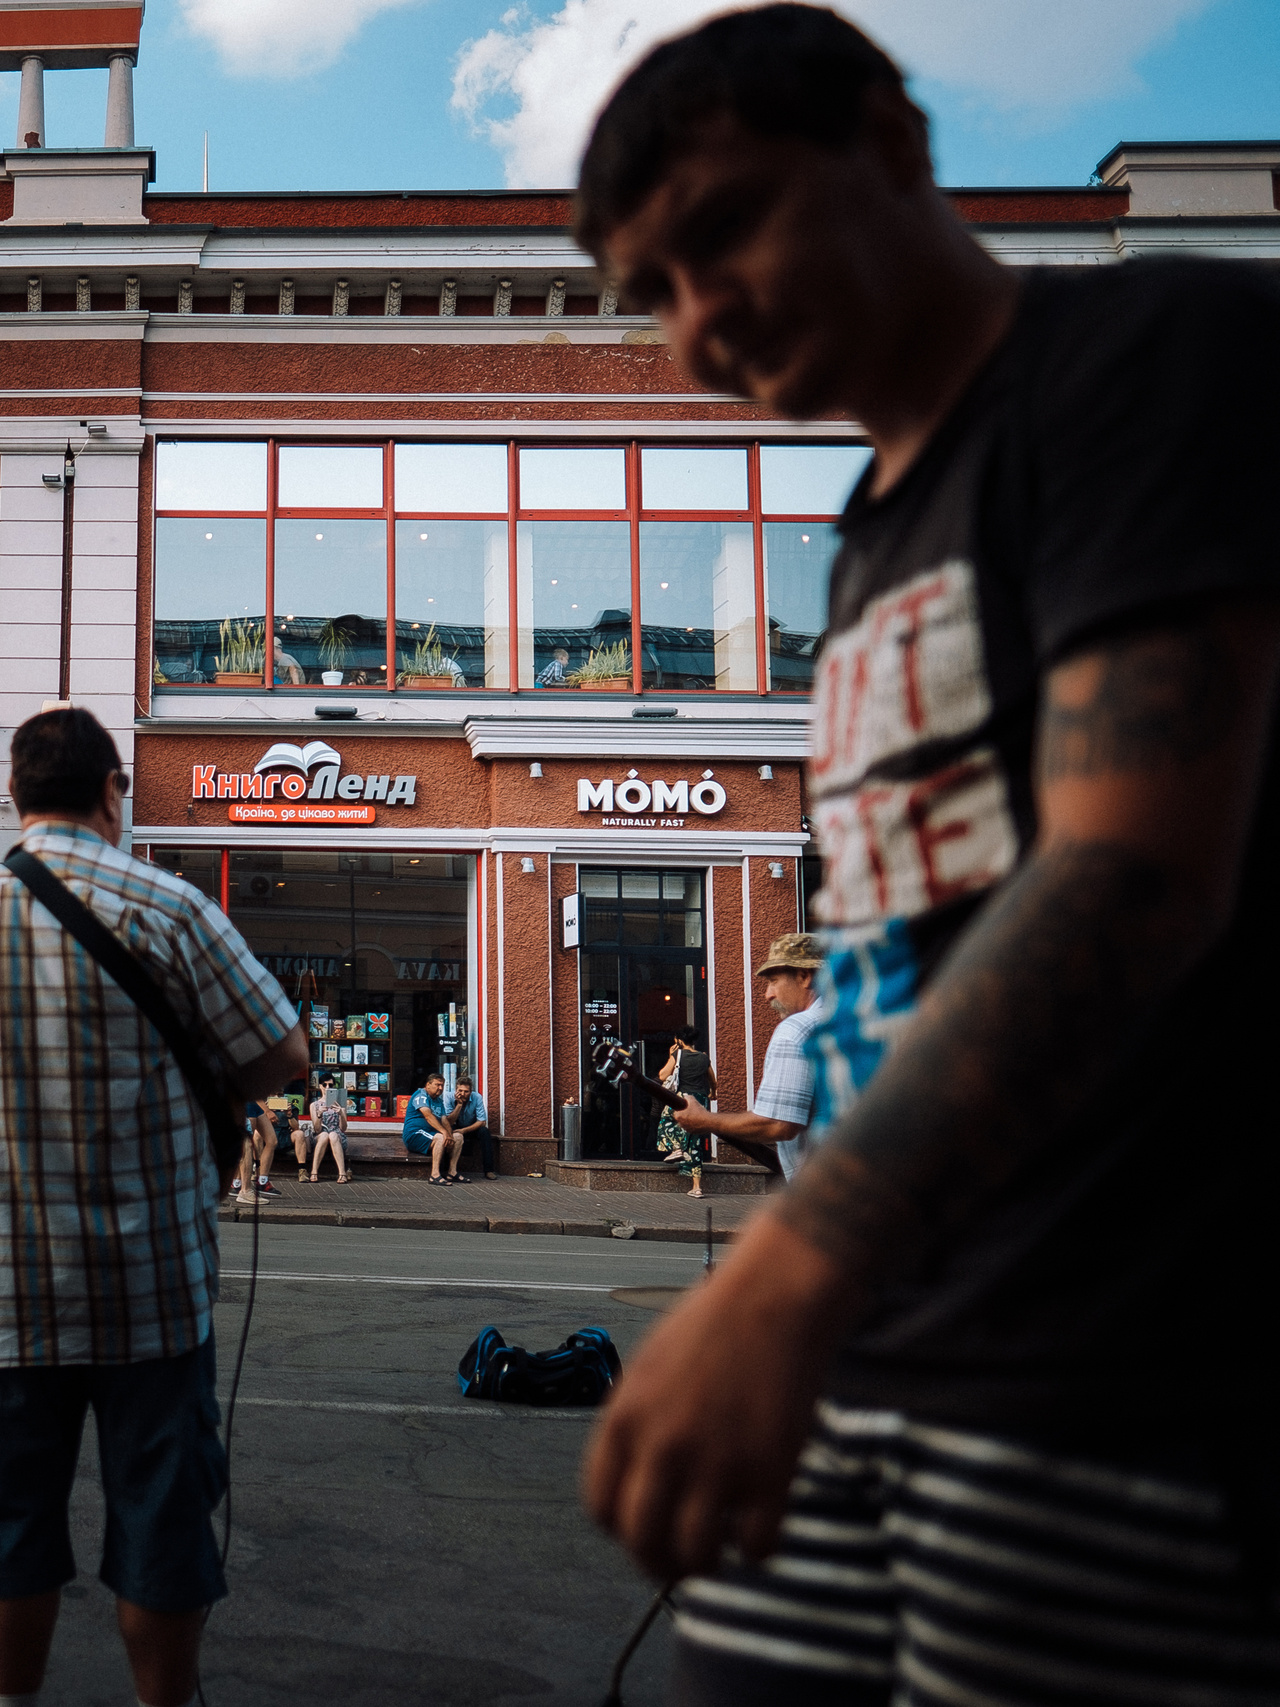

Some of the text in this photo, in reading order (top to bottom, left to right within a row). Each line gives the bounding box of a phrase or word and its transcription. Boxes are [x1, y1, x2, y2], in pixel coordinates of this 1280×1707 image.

[235, 806, 368, 821] Країна, де цікаво жити!
[602, 818, 685, 827] NATURALLY FAST
